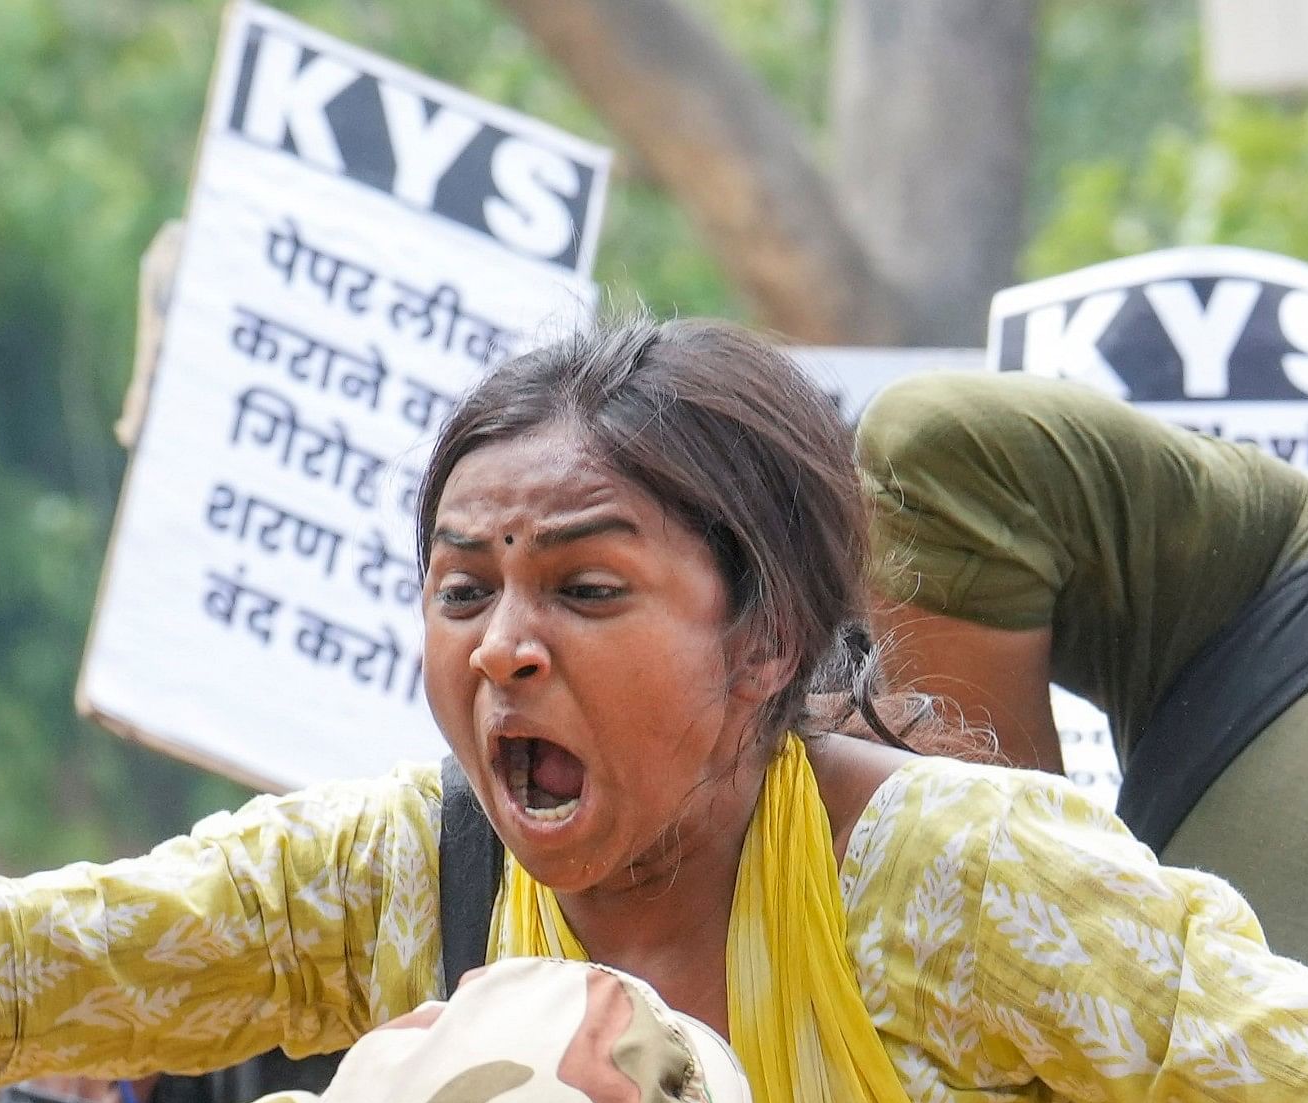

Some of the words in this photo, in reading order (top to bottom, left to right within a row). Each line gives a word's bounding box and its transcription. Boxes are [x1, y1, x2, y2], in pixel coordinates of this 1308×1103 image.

[242, 35, 583, 260] KYS
[266, 218, 376, 314] पेपर
[229, 304, 390, 412] कराने
[205, 481, 345, 577] शरण
